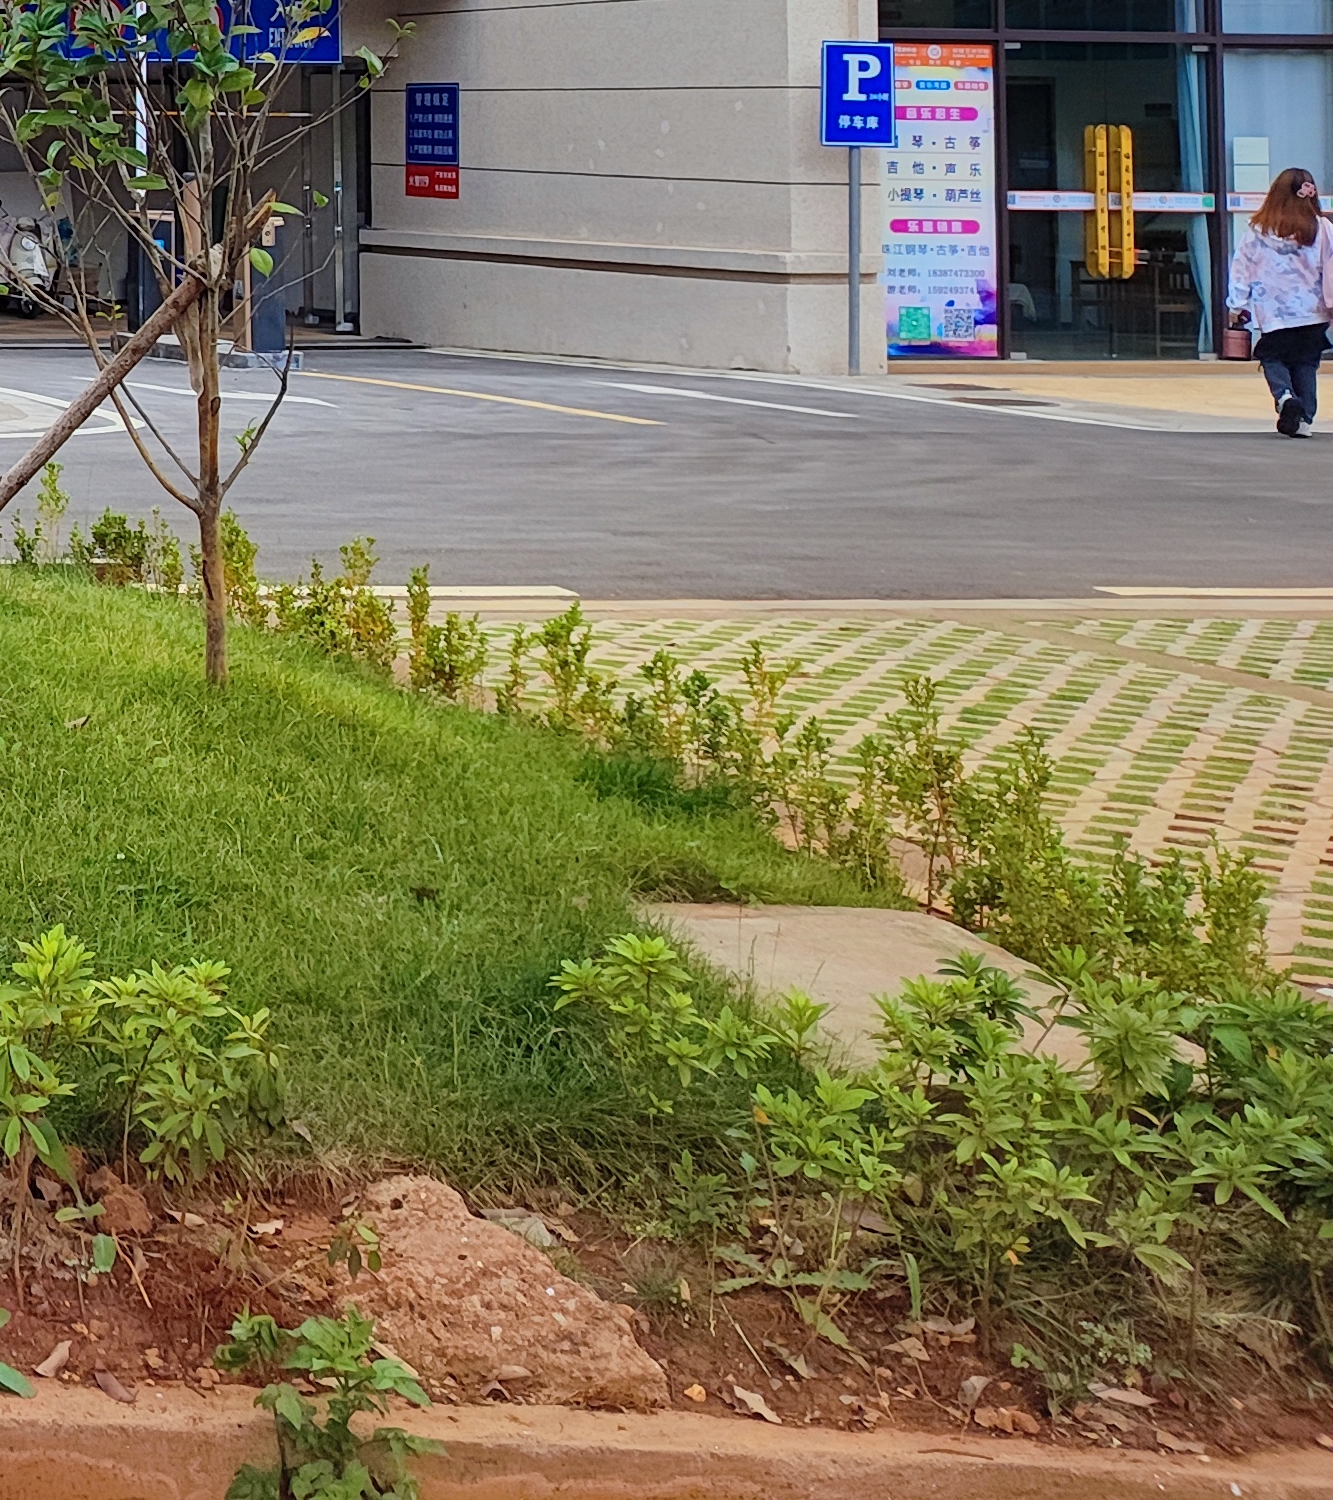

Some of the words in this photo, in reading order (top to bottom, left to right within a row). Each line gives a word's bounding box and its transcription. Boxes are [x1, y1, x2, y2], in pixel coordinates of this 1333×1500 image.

[842, 53, 882, 102] P
[838, 114, 879, 129] 停车库
